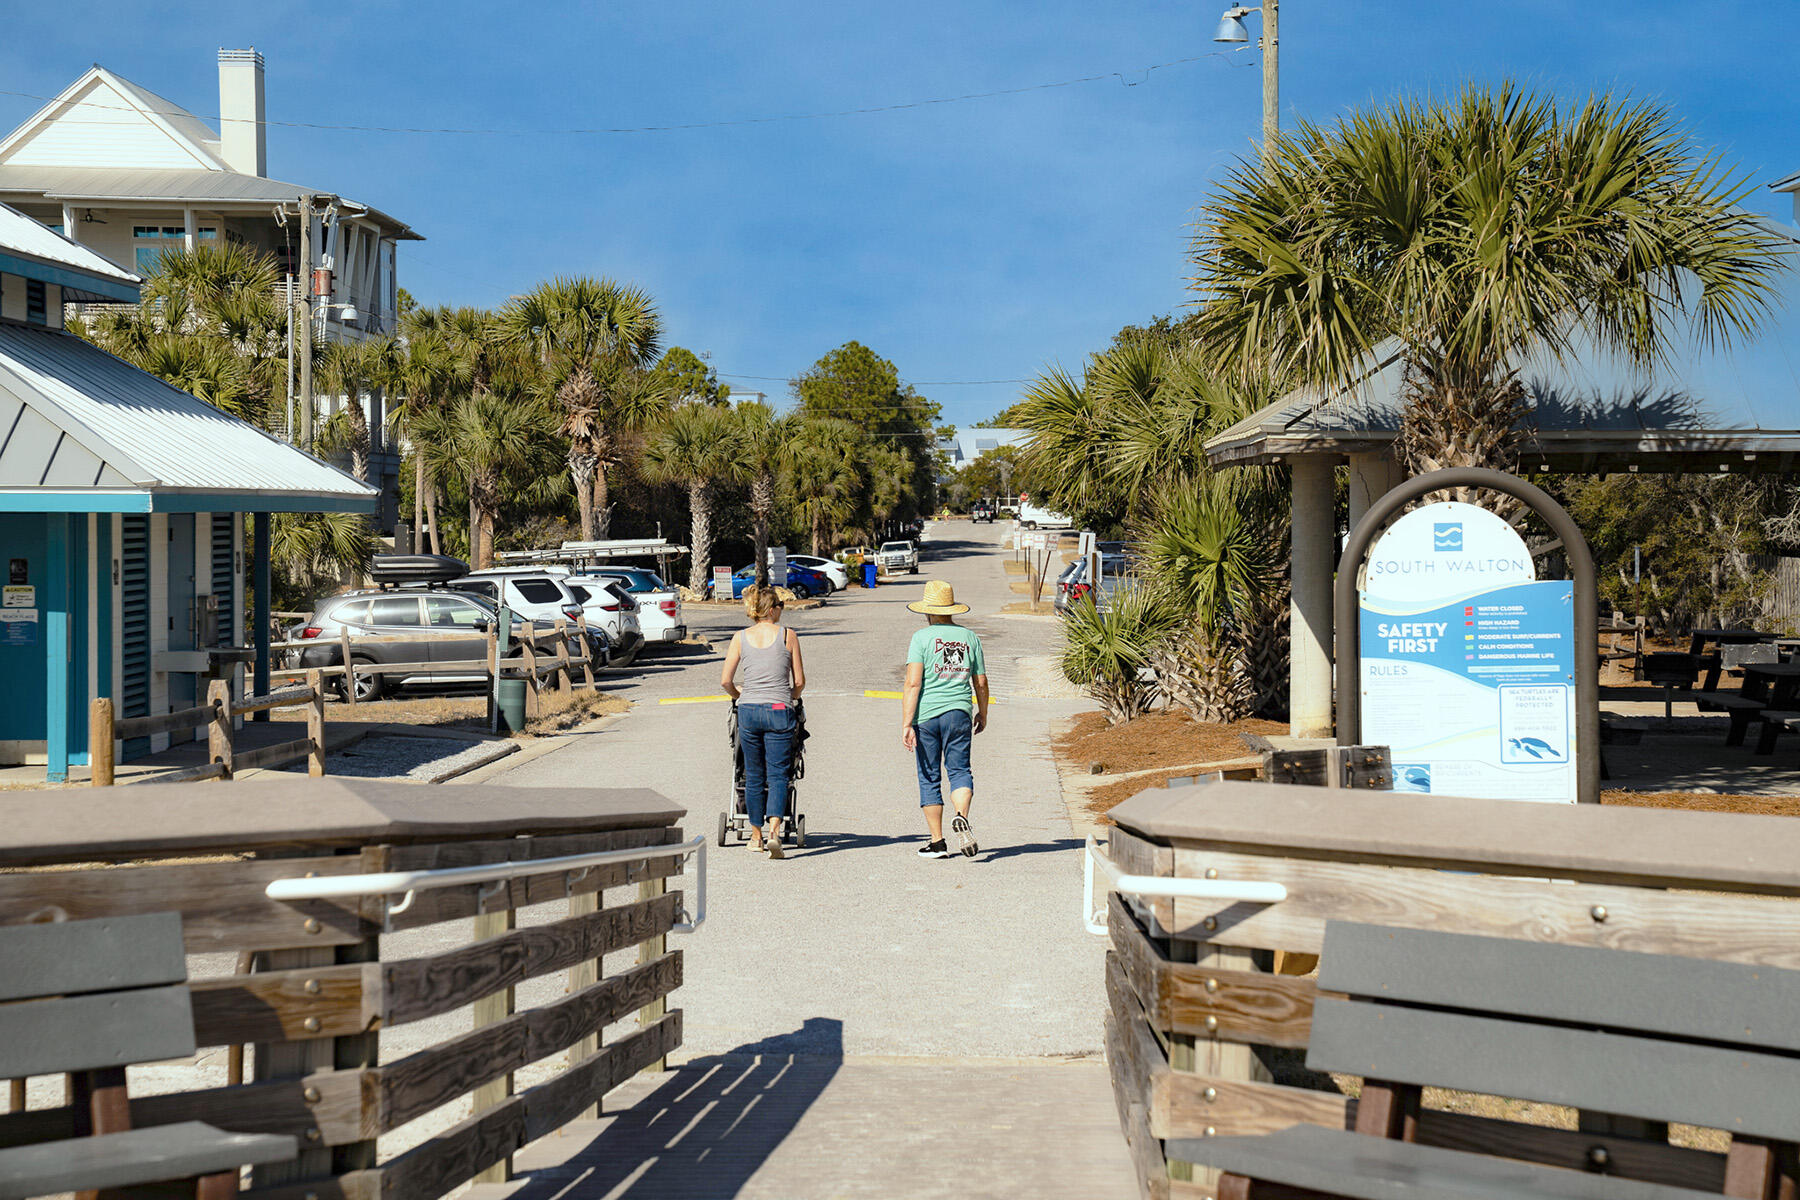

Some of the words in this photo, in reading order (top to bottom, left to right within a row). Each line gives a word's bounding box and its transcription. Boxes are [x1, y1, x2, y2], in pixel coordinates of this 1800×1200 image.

[1375, 560, 1435, 574] SOUTH
[1446, 558, 1524, 572] WALTON
[1377, 622, 1448, 638] SAFETY
[1388, 638, 1439, 653] FIRST
[1369, 665, 1408, 676] RULES
